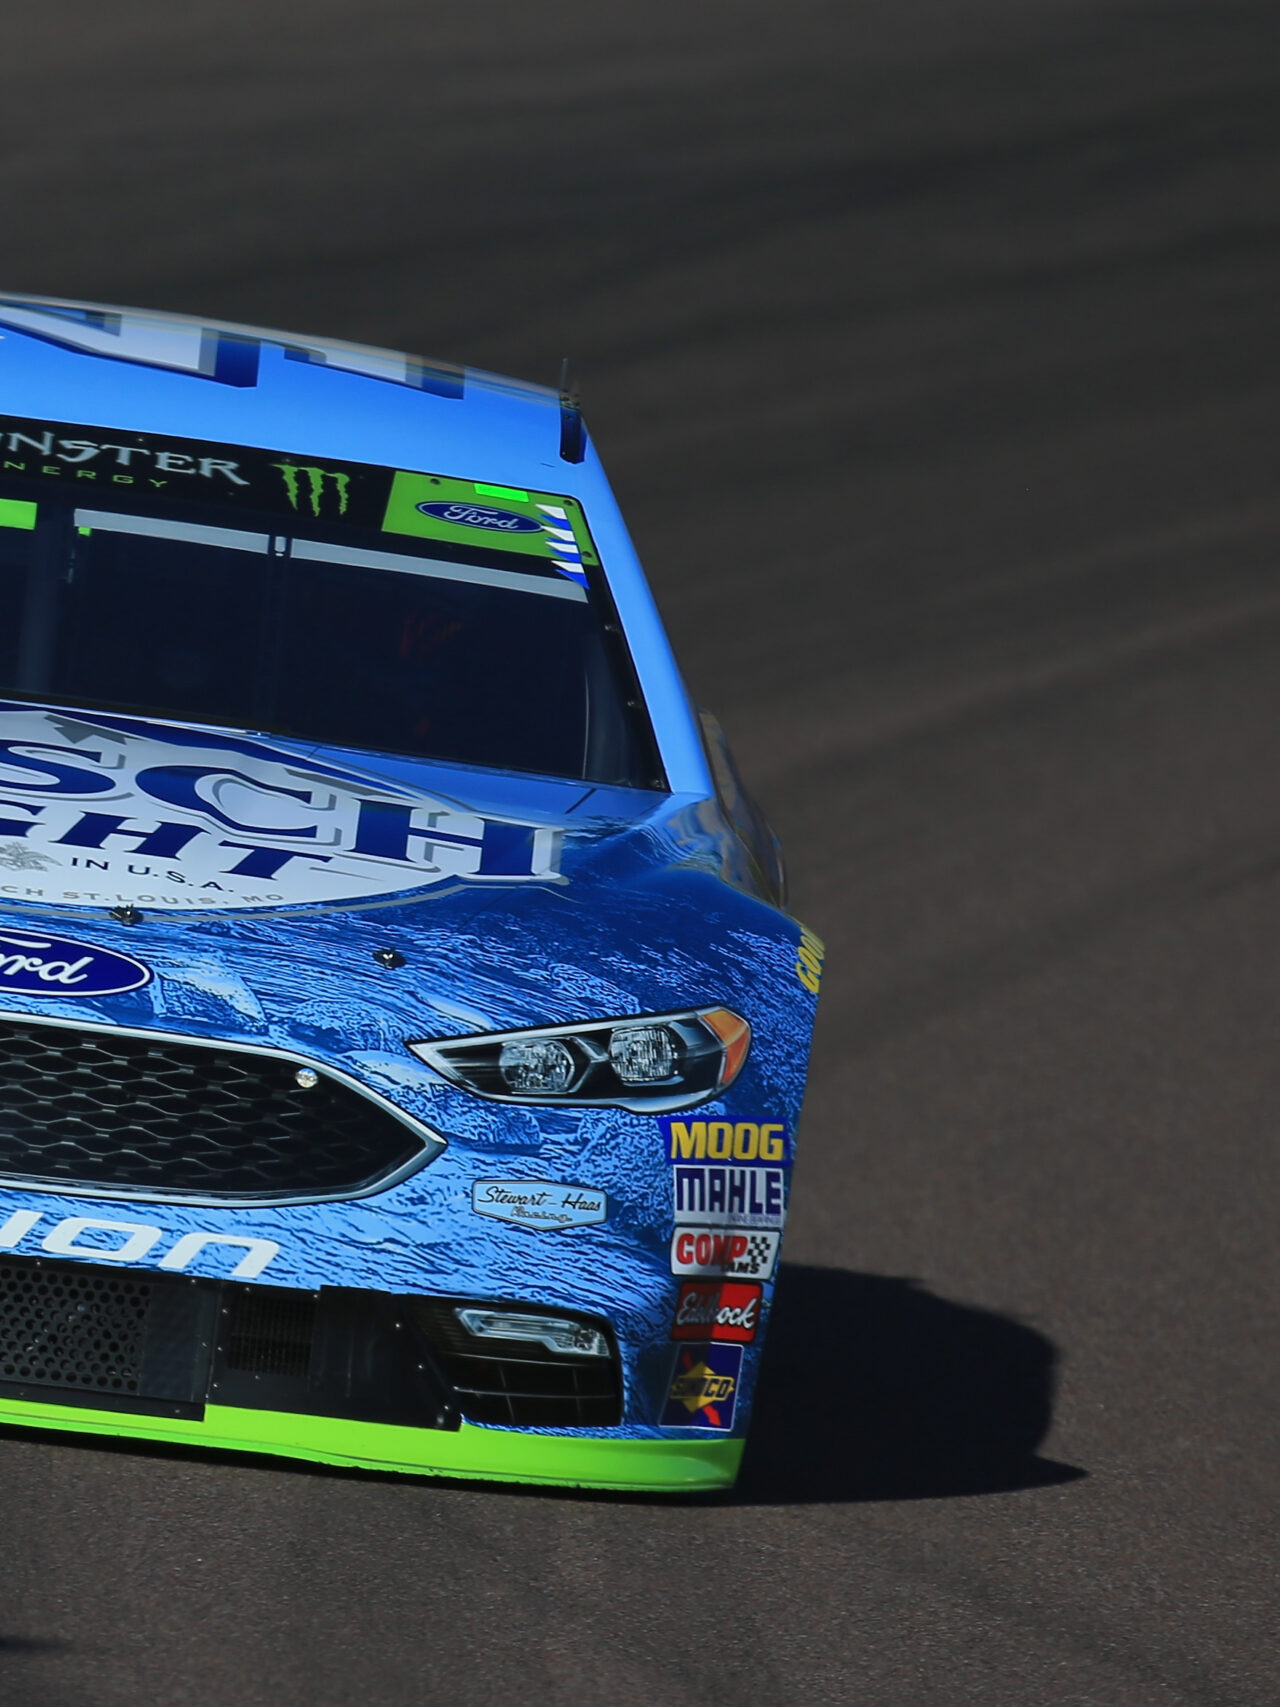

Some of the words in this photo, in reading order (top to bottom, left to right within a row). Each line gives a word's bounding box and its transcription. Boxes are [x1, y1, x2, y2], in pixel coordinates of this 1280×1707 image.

[443, 504, 519, 530] Ford
[71, 856, 110, 871] IN
[670, 1121, 785, 1161] MOOG
[675, 1167, 782, 1215] MAHLE
[676, 1232, 749, 1266] COMP
